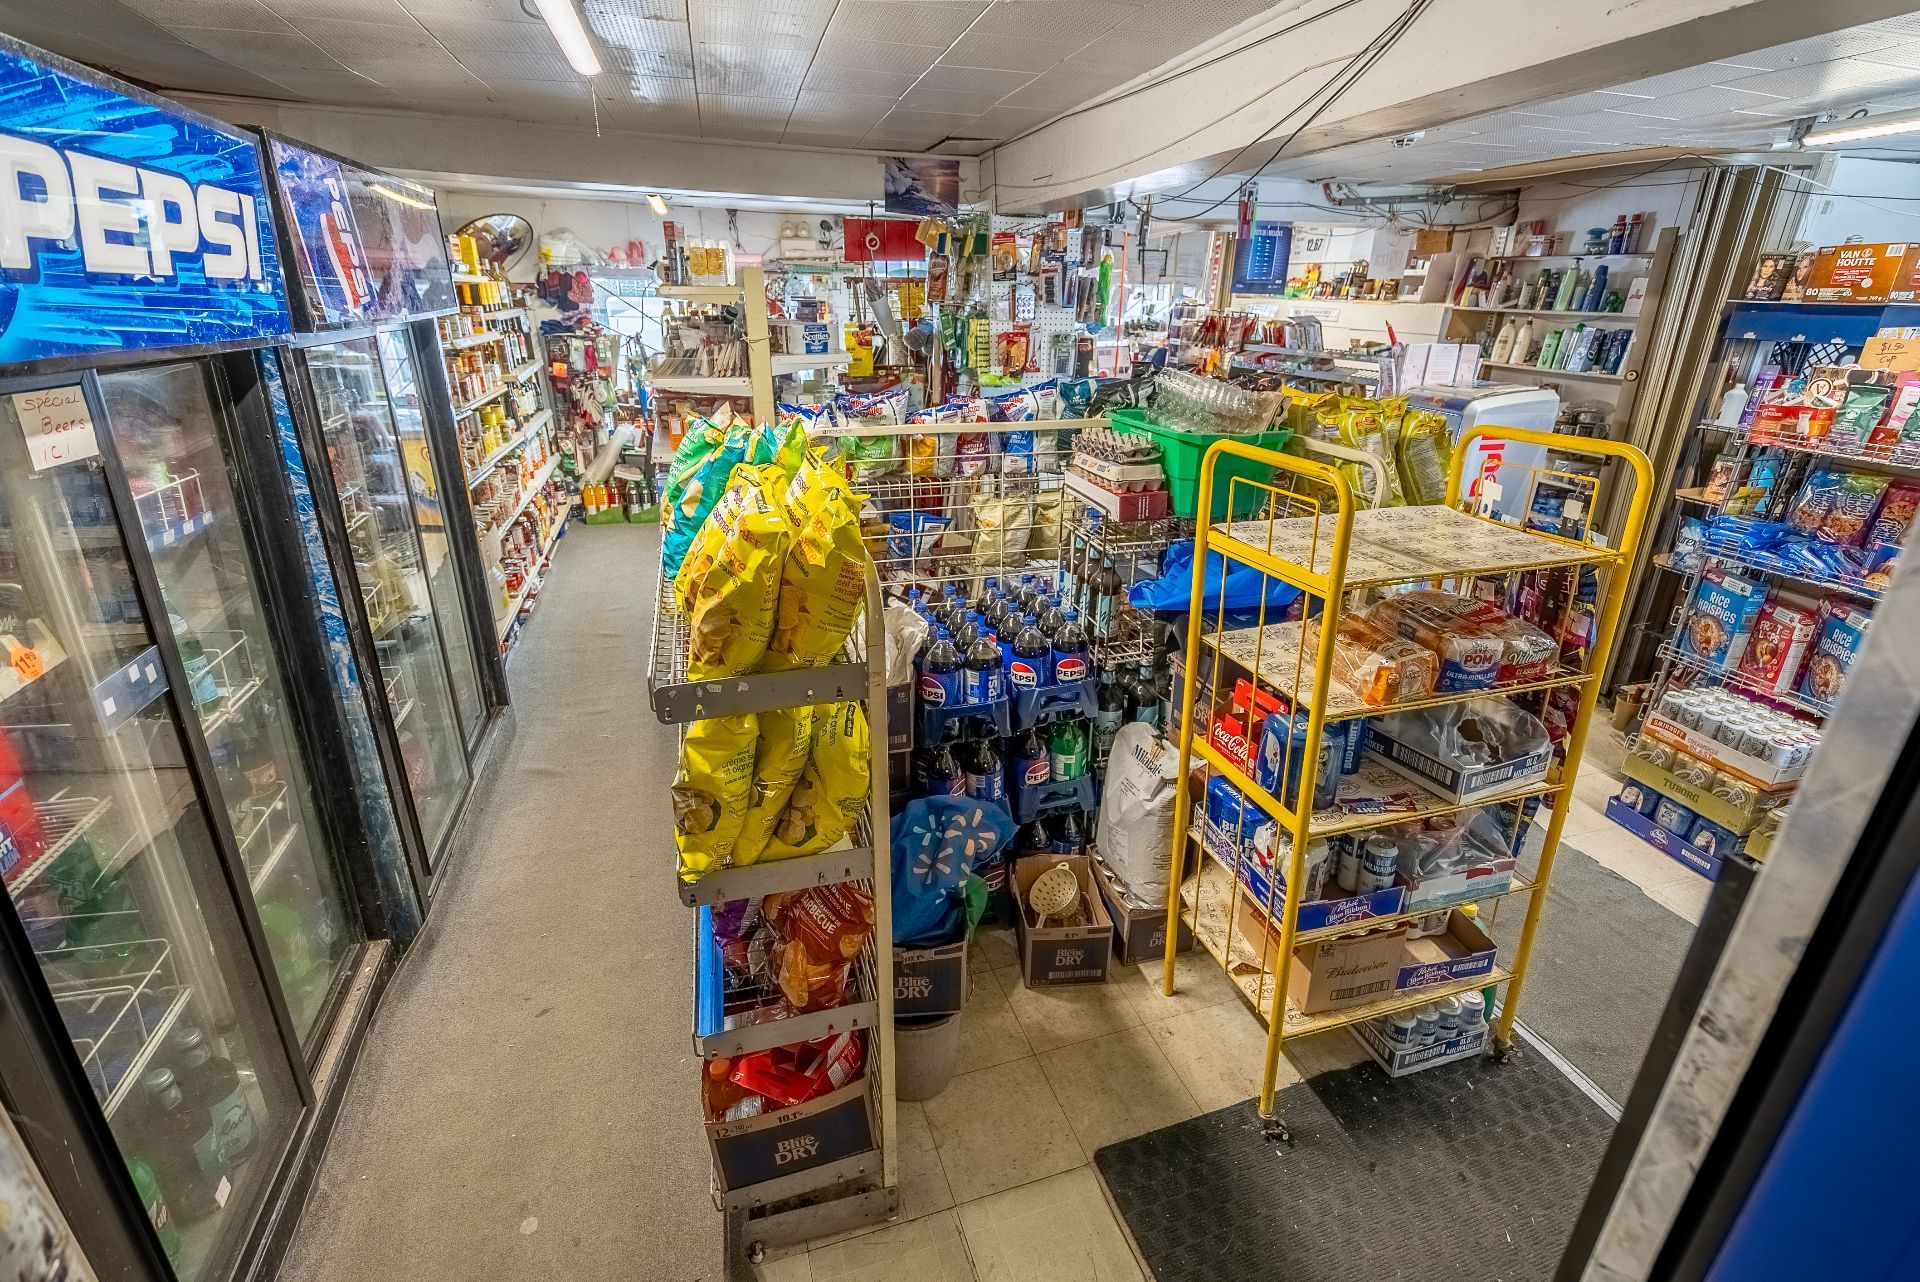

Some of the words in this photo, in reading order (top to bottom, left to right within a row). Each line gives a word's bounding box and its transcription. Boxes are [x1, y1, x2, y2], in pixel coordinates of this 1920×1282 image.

[0, 132, 262, 281] PEPSI
[323, 177, 370, 307] PEPSI
[1836, 258, 1877, 266] HOUTTE
[1840, 250, 1860, 259] VAN
[1806, 288, 1819, 296] 80
[802, 331, 831, 344] Scotties
[1881, 341, 1905, 353] $1.50
[41, 416, 86, 435] Beers
[1709, 591, 1731, 607] RICE
[1698, 599, 1737, 624] KRISPIES
[1832, 628, 1853, 647] RICE
[1463, 654, 1494, 666] POM
[1820, 640, 1857, 666] KRISPIES
[1011, 672, 1035, 684] PEPSI
[1057, 668, 1086, 678] PEPSI
[1346, 720, 1359, 751] LIGHT
[1653, 719, 1685, 738] SMIRNOFF
[1212, 722, 1249, 760] Coca-Cola
[1344, 751, 1353, 769] BUD
[1525, 756, 1538, 767] OLD
[1512, 763, 1547, 781] MILWAUKEE
[1663, 777, 1700, 804] TUBORG
[1375, 858, 1392, 867] OLD
[800, 893, 837, 935] BARBECUE
[1055, 955, 1085, 966] DRY
[1325, 959, 1389, 980] Budweiser
[894, 983, 934, 1000] DRY
[1445, 1041, 1480, 1055] MILWAUKEE
[1459, 1036, 1473, 1046] OLD
[716, 1128, 731, 1138] 12
[774, 1140, 821, 1165] DRY
